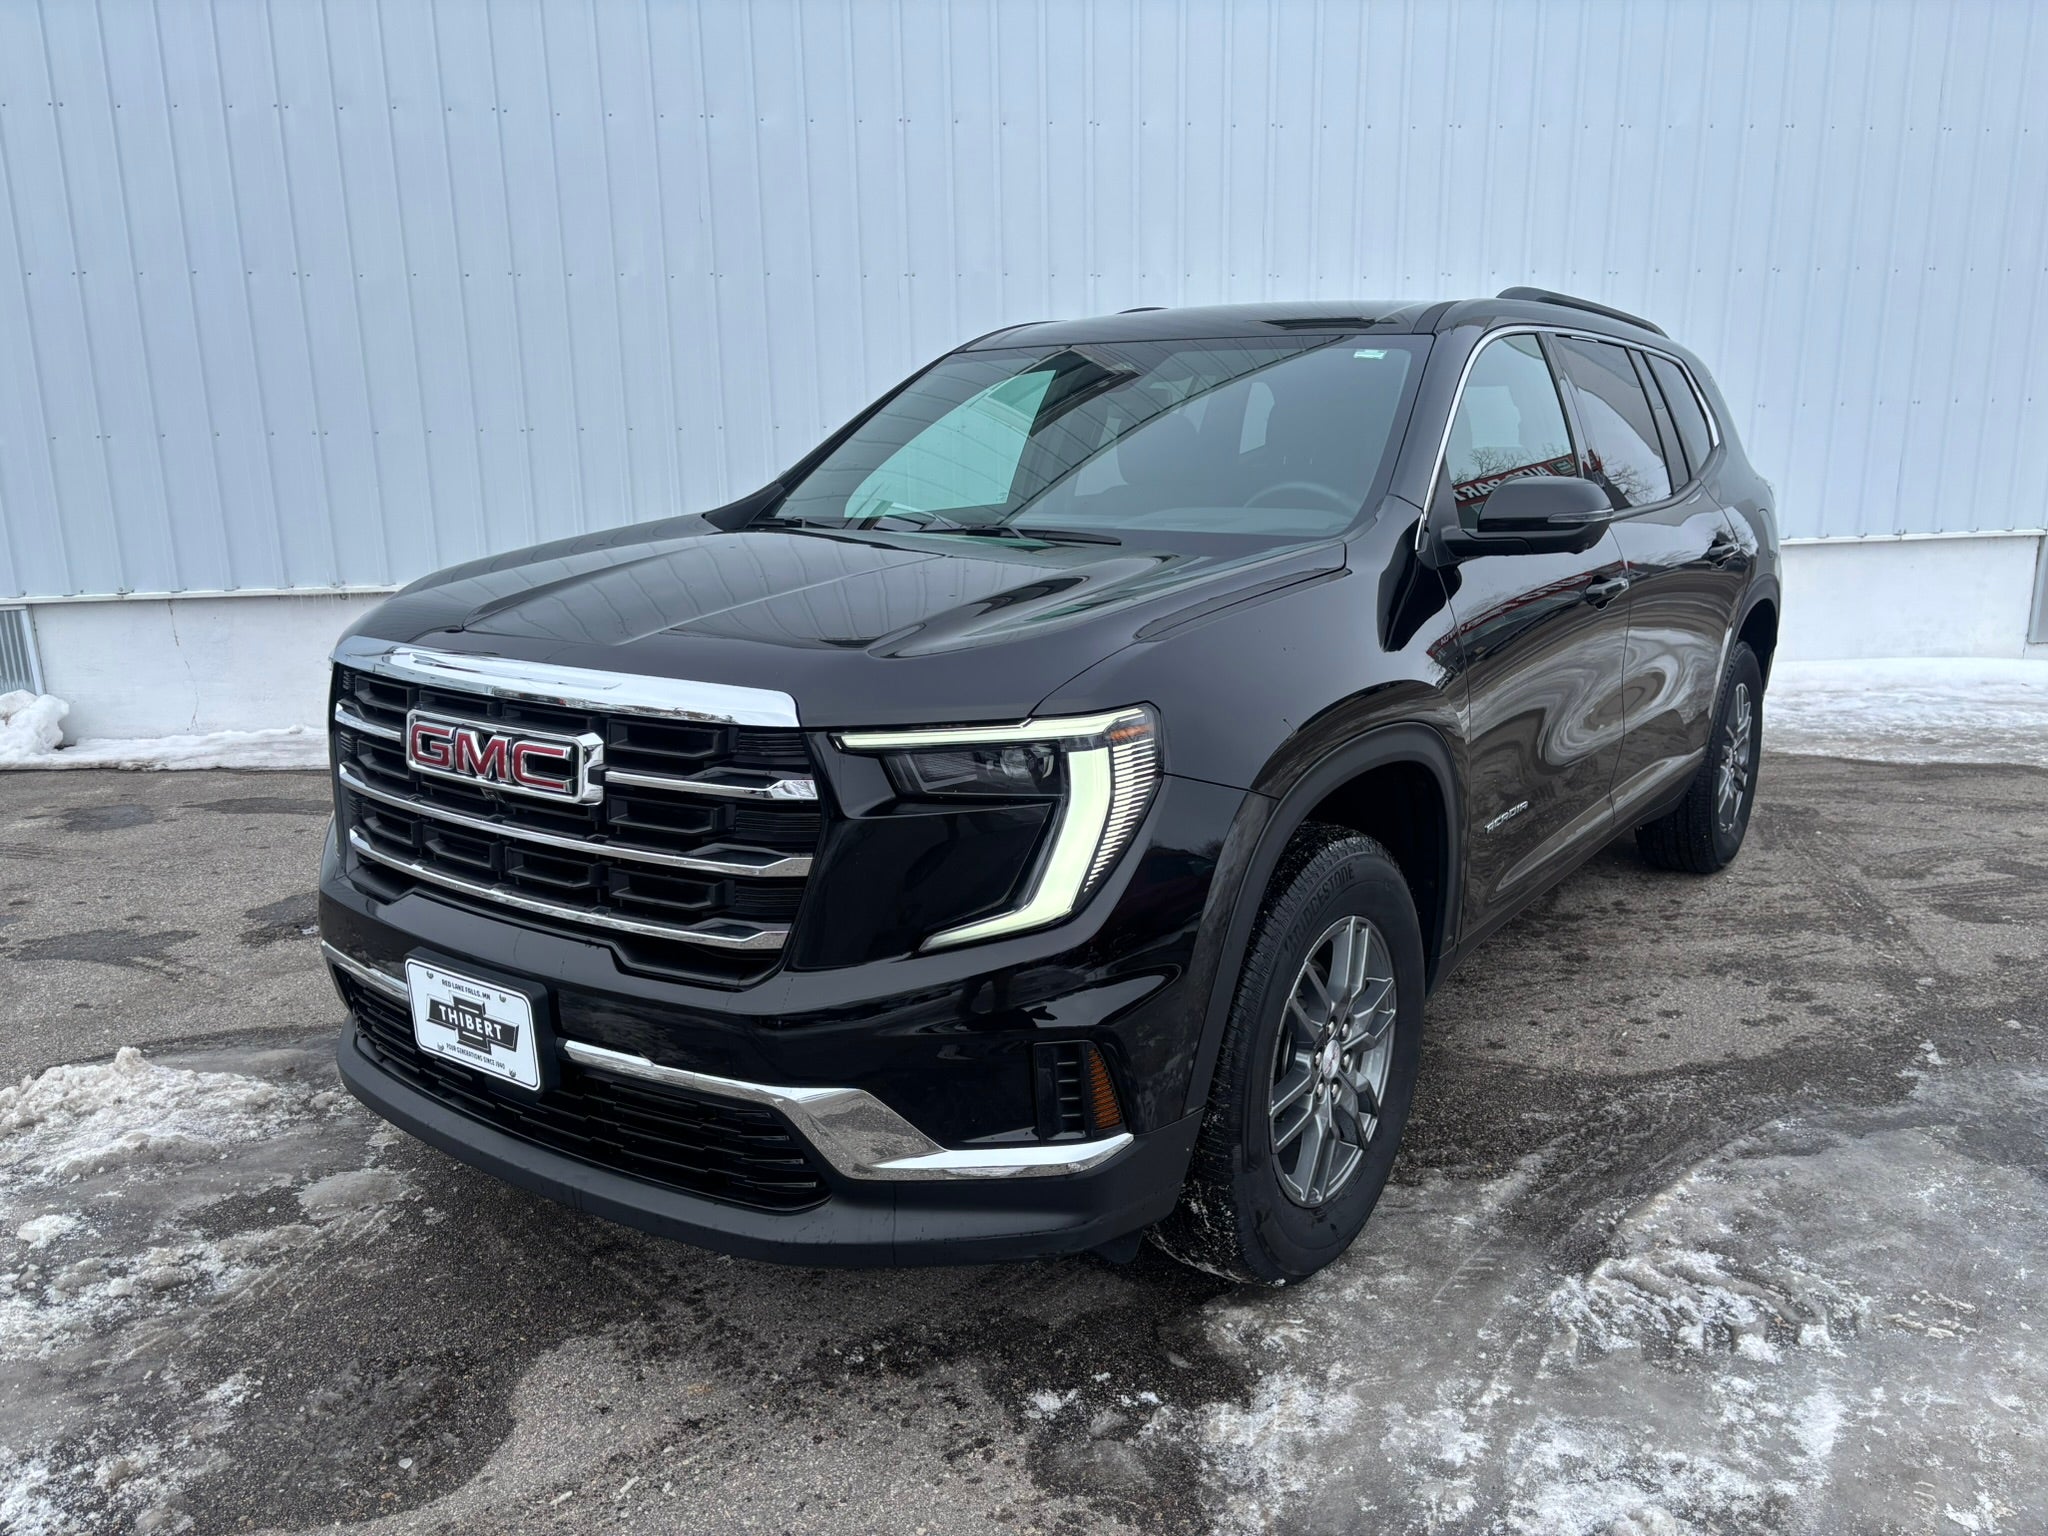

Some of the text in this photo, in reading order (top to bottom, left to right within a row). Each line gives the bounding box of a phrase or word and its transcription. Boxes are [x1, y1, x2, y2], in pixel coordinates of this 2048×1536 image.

[411, 721, 573, 793] GMC
[441, 979, 451, 988] RED
[452, 982, 464, 993] LAKE
[438, 1005, 502, 1040] THIBERT
[483, 1057, 495, 1066] SINCE
